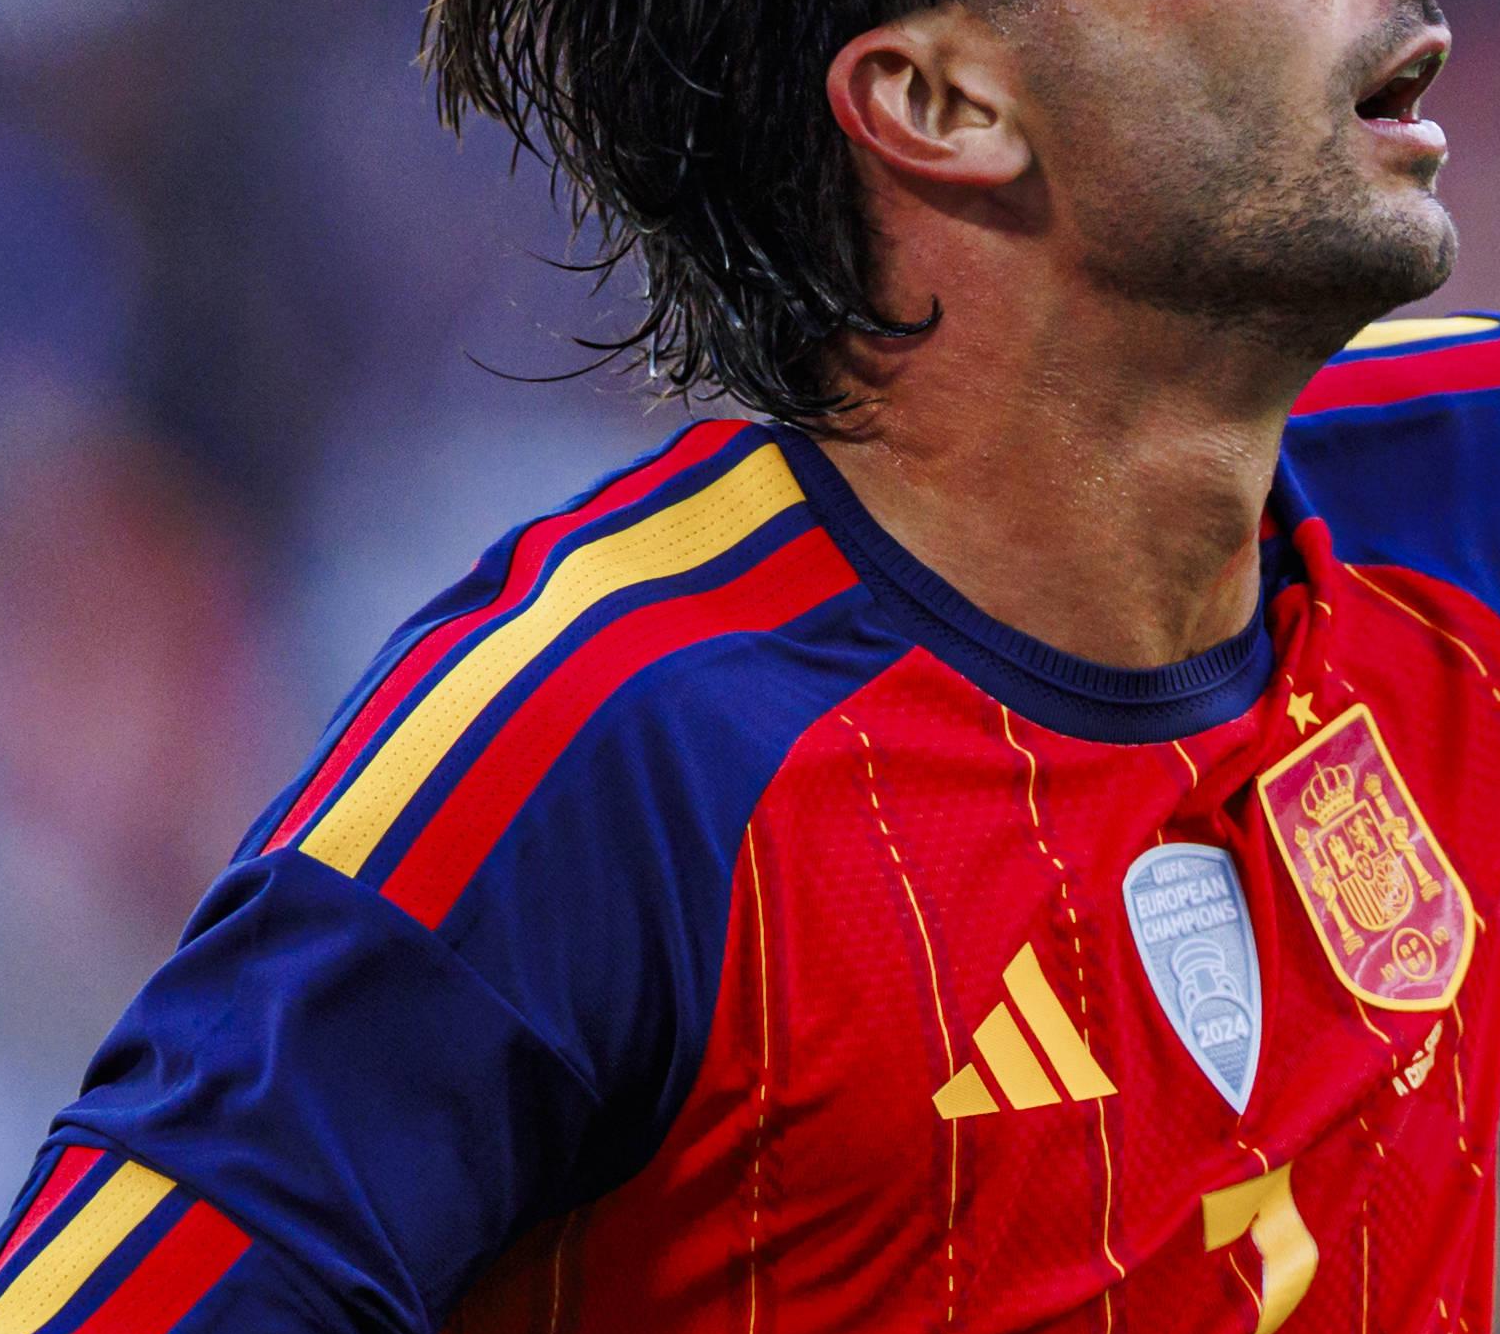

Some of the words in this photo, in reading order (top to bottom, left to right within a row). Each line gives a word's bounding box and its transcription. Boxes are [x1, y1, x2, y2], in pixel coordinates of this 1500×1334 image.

[1152, 861, 1188, 884] UEFA
[1135, 874, 1228, 919] EUROPEAN
[1143, 899, 1238, 943] CHAMPIONS
[1196, 1014, 1248, 1047] 2024
